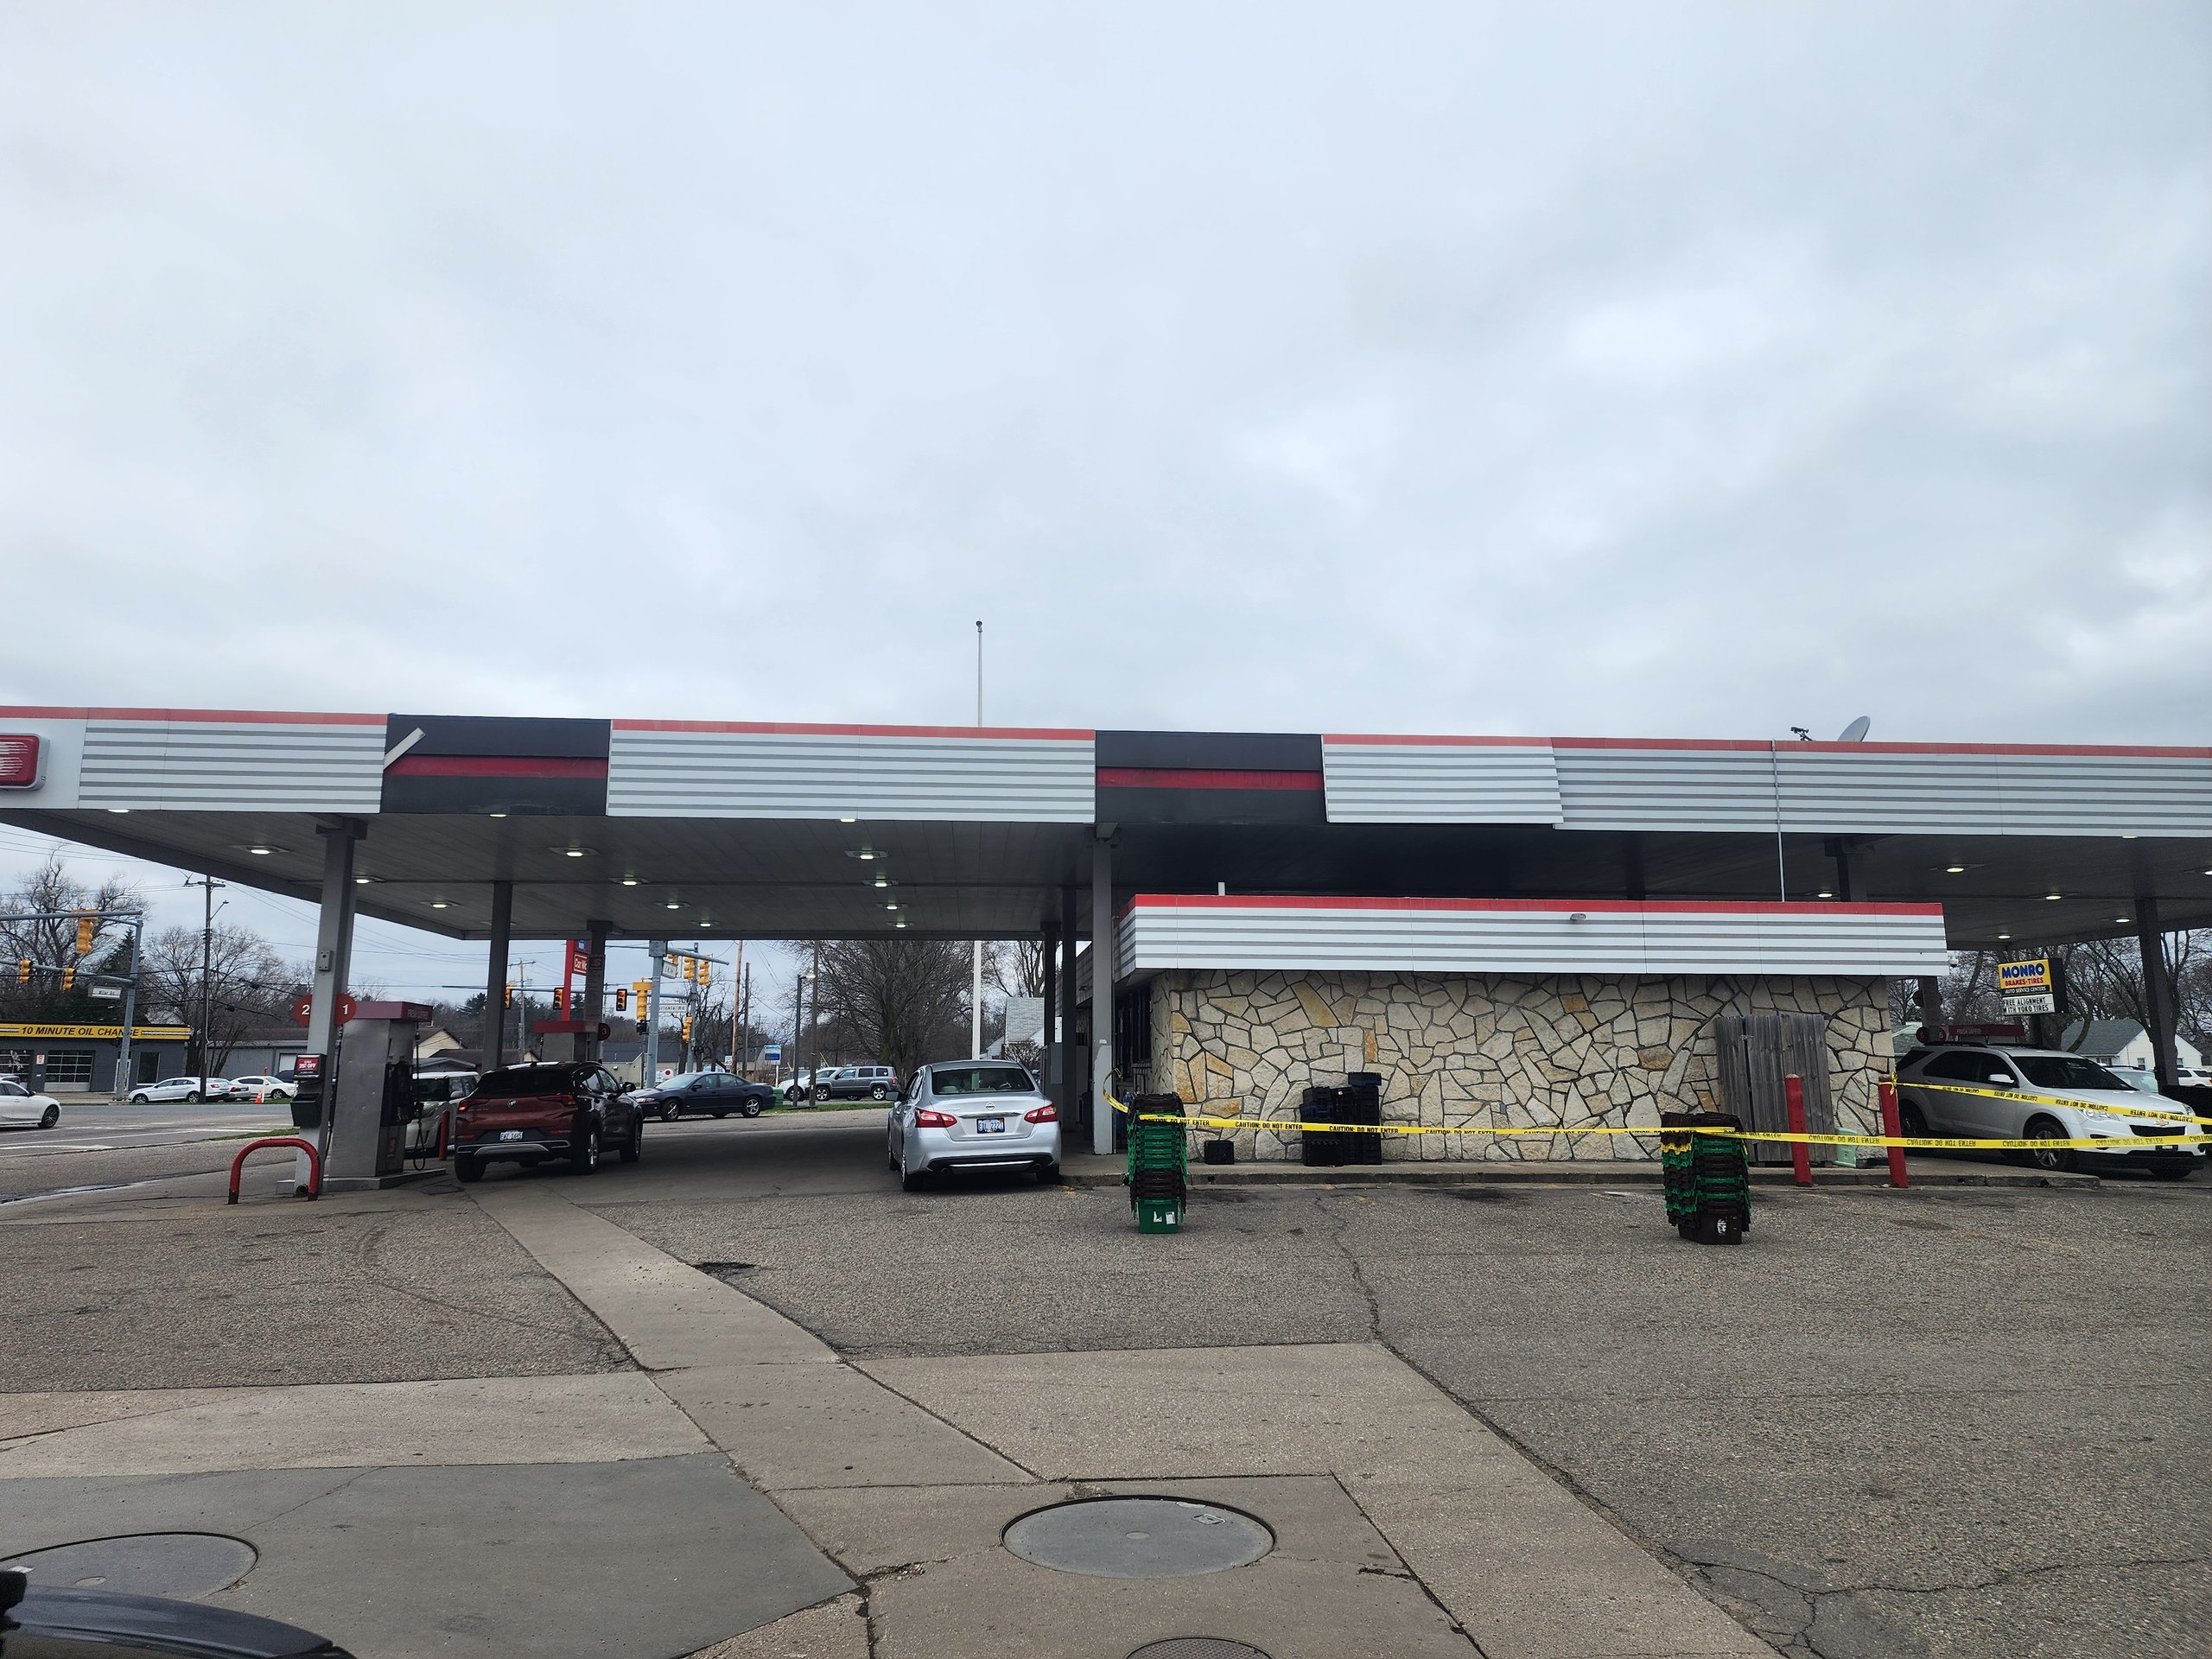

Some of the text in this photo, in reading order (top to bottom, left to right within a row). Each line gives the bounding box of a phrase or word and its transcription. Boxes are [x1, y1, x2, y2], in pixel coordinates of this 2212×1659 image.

[2002, 963, 2045, 979] MONRO
[302, 1004, 310, 1015] 2
[342, 1004, 348, 1015] 1
[36, 1027, 75, 1035] MINUTE
[78, 1028, 94, 1036] OIL
